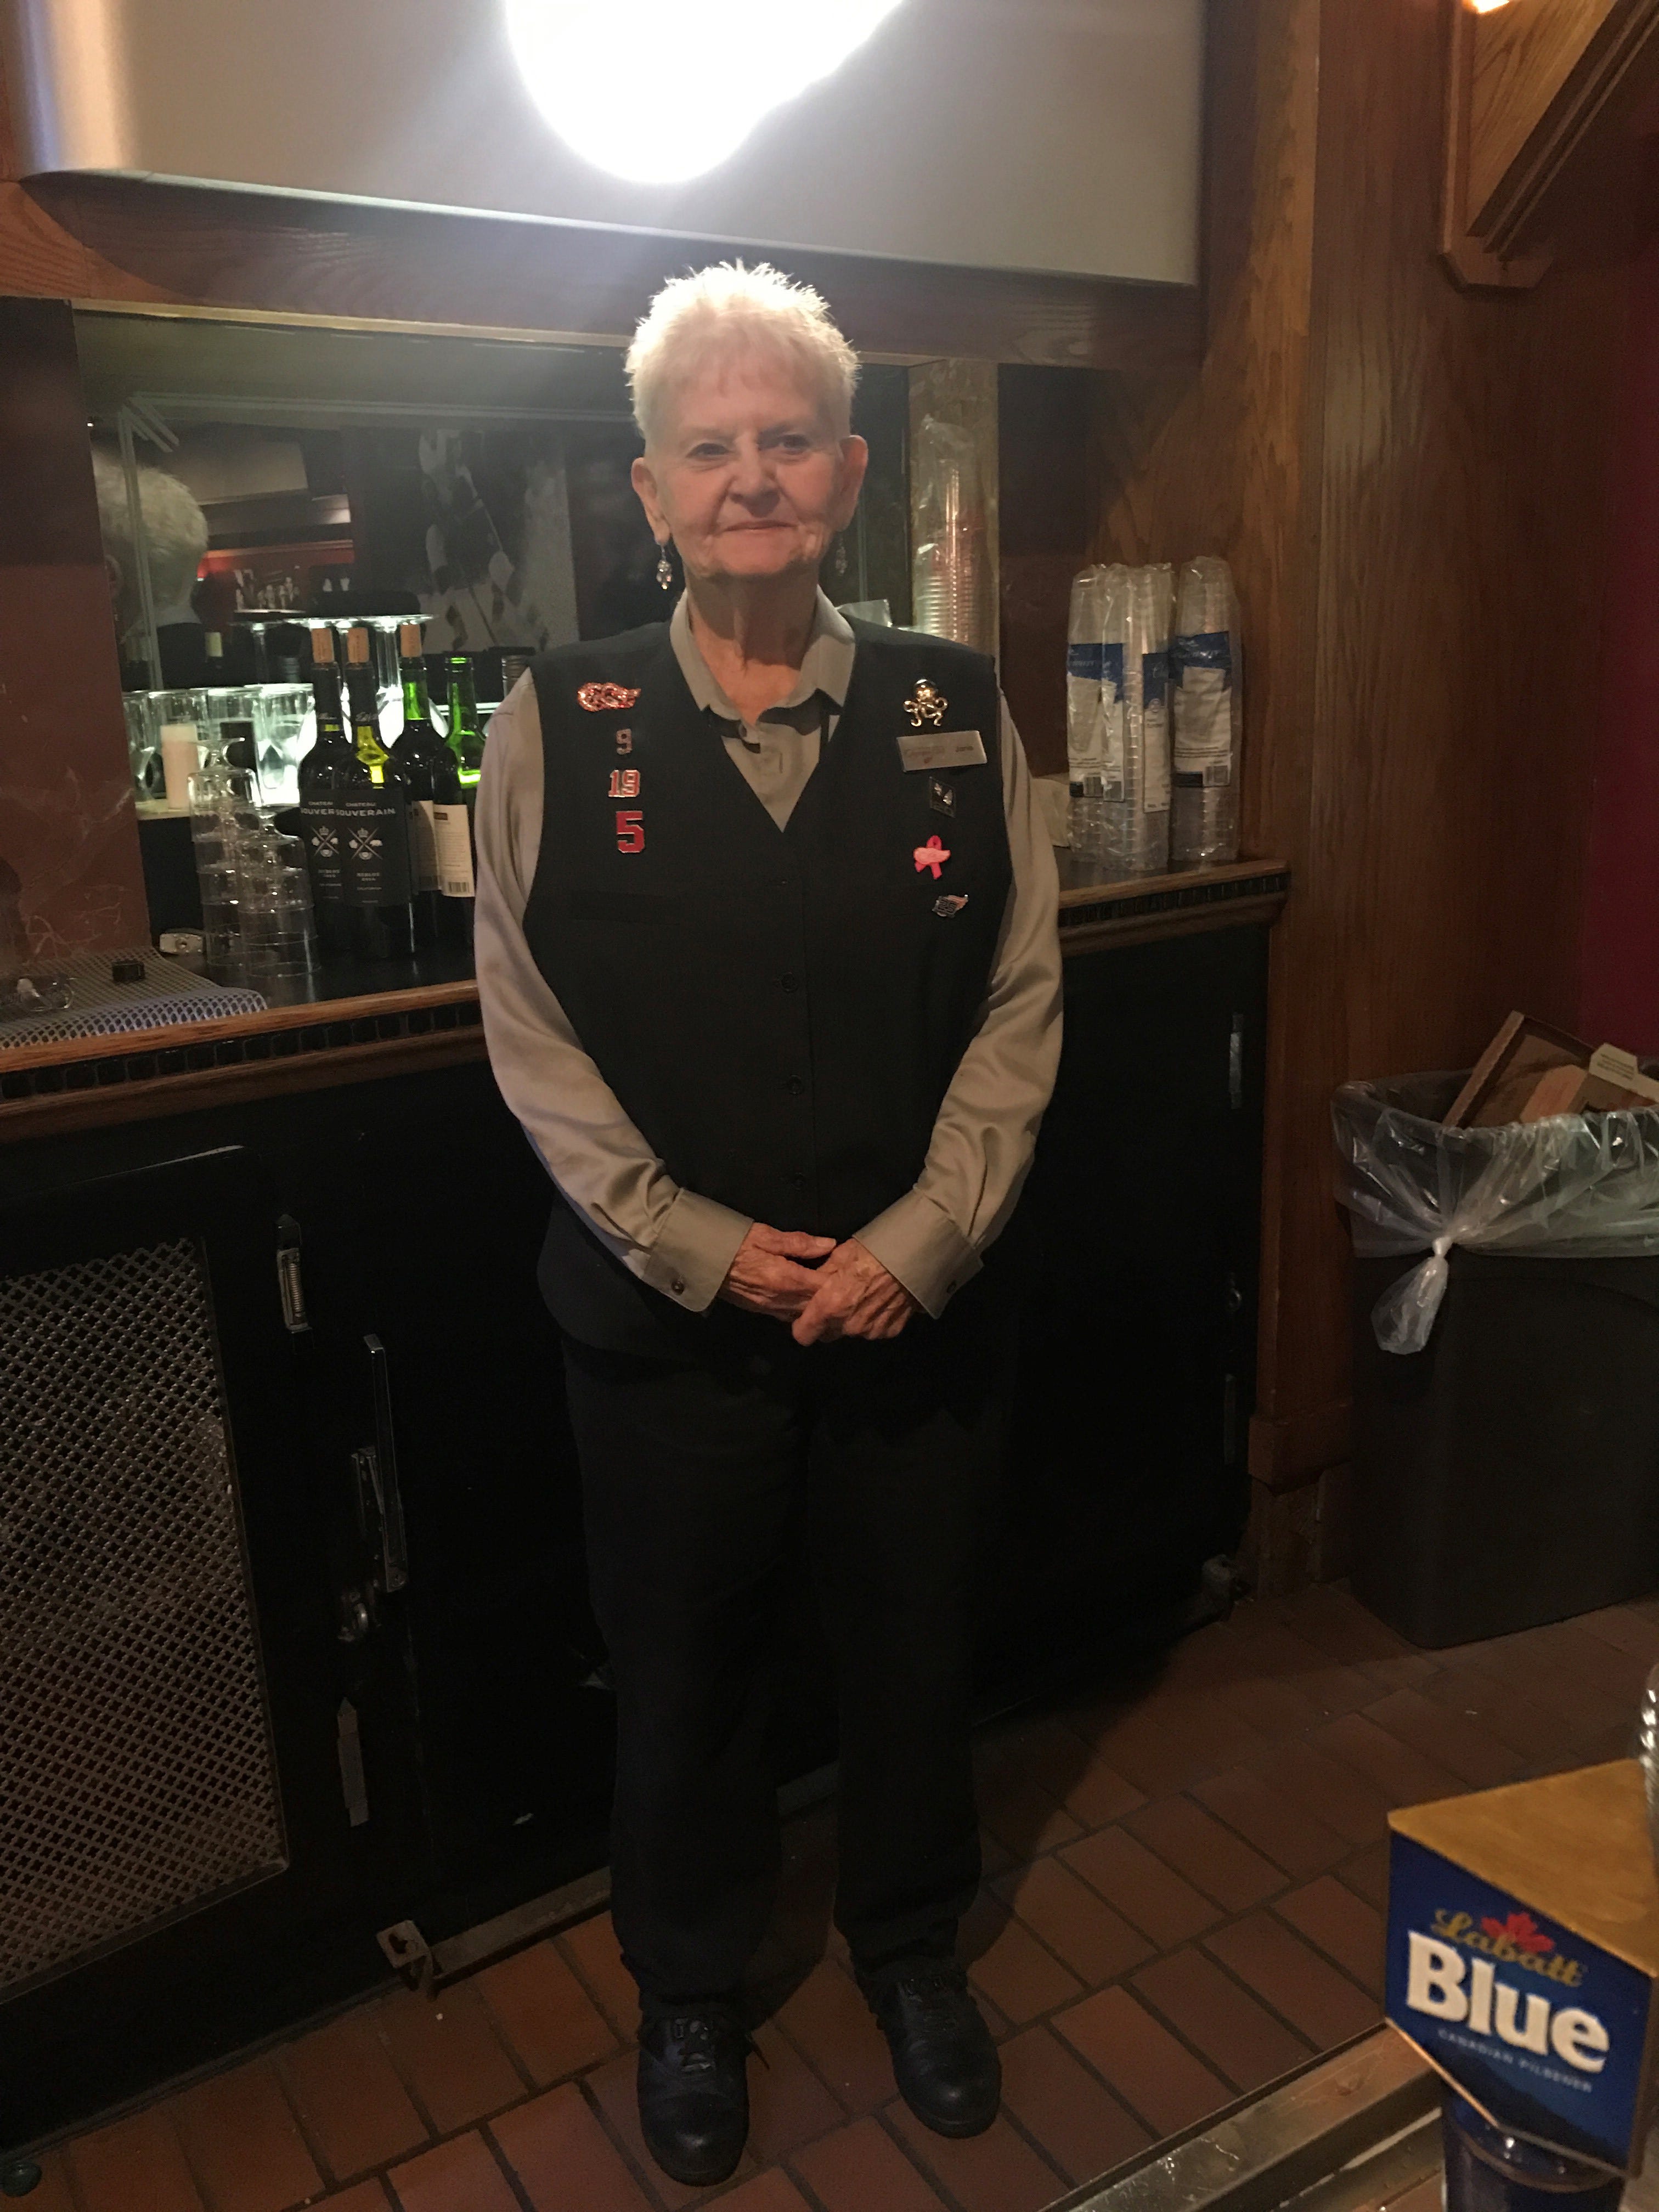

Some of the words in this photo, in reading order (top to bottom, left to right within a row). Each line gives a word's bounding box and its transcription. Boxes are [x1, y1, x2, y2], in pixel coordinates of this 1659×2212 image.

[616, 729, 632, 755] 9
[608, 769, 641, 797] 19
[335, 808, 396, 816] SOUVERAIN
[616, 811, 645, 853] 5
[1430, 1908, 1588, 1988] Labatt
[1407, 1929, 1610, 2074] Blue
[1437, 2029, 1514, 2064] CANADIAN
[1518, 2057, 1593, 2093] PILSENER
